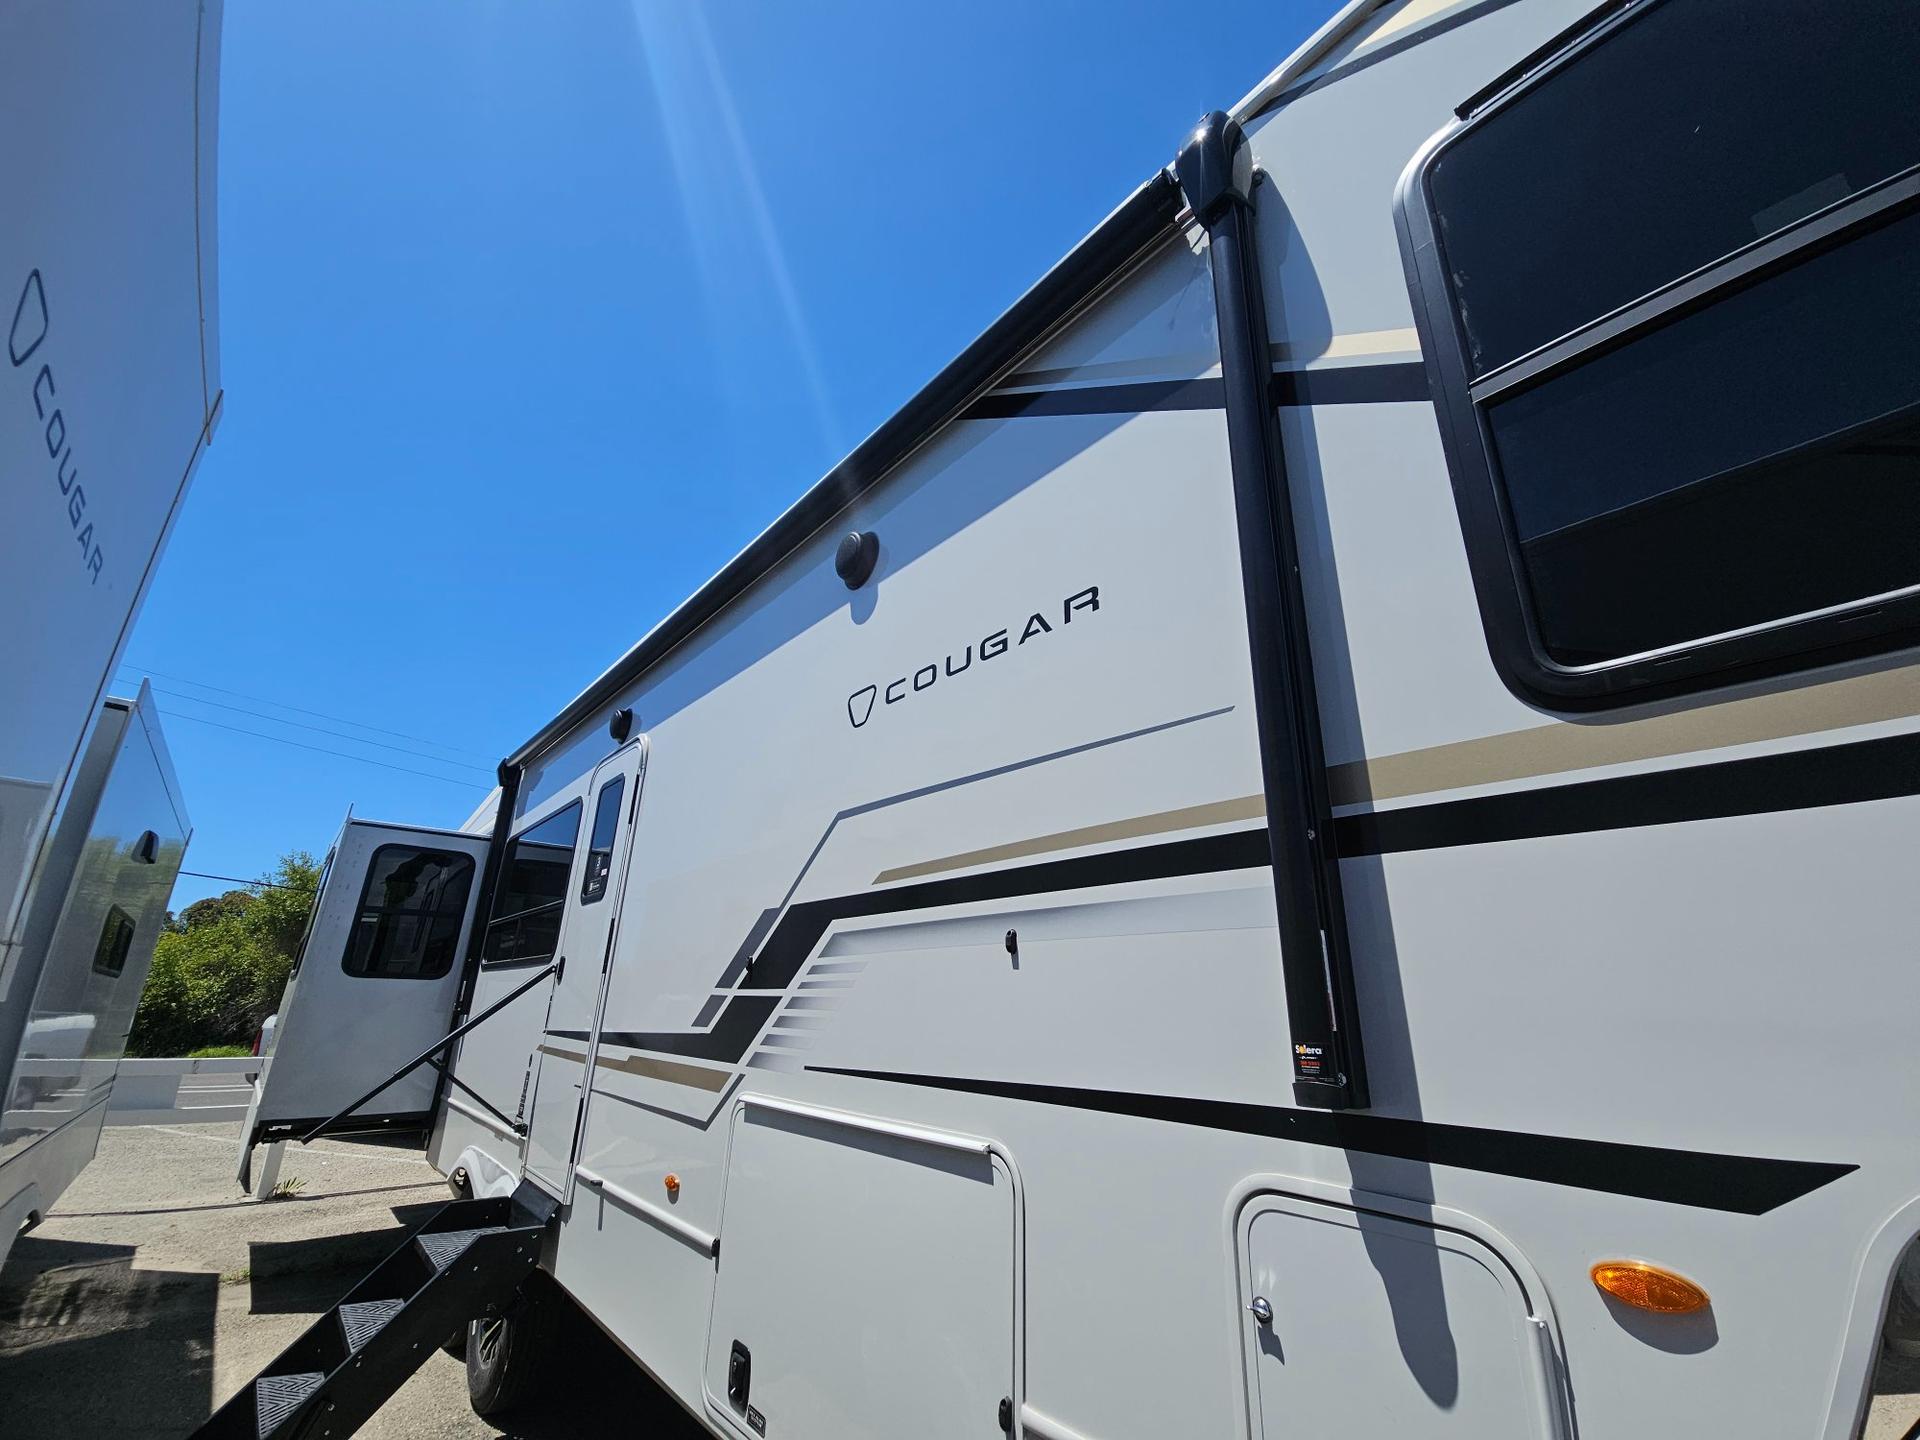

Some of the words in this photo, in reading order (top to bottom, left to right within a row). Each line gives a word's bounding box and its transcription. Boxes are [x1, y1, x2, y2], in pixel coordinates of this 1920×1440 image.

[33, 364, 103, 585] COUGAR
[885, 586, 1100, 704] COUGAR
[1295, 1044, 1322, 1055] Solera
